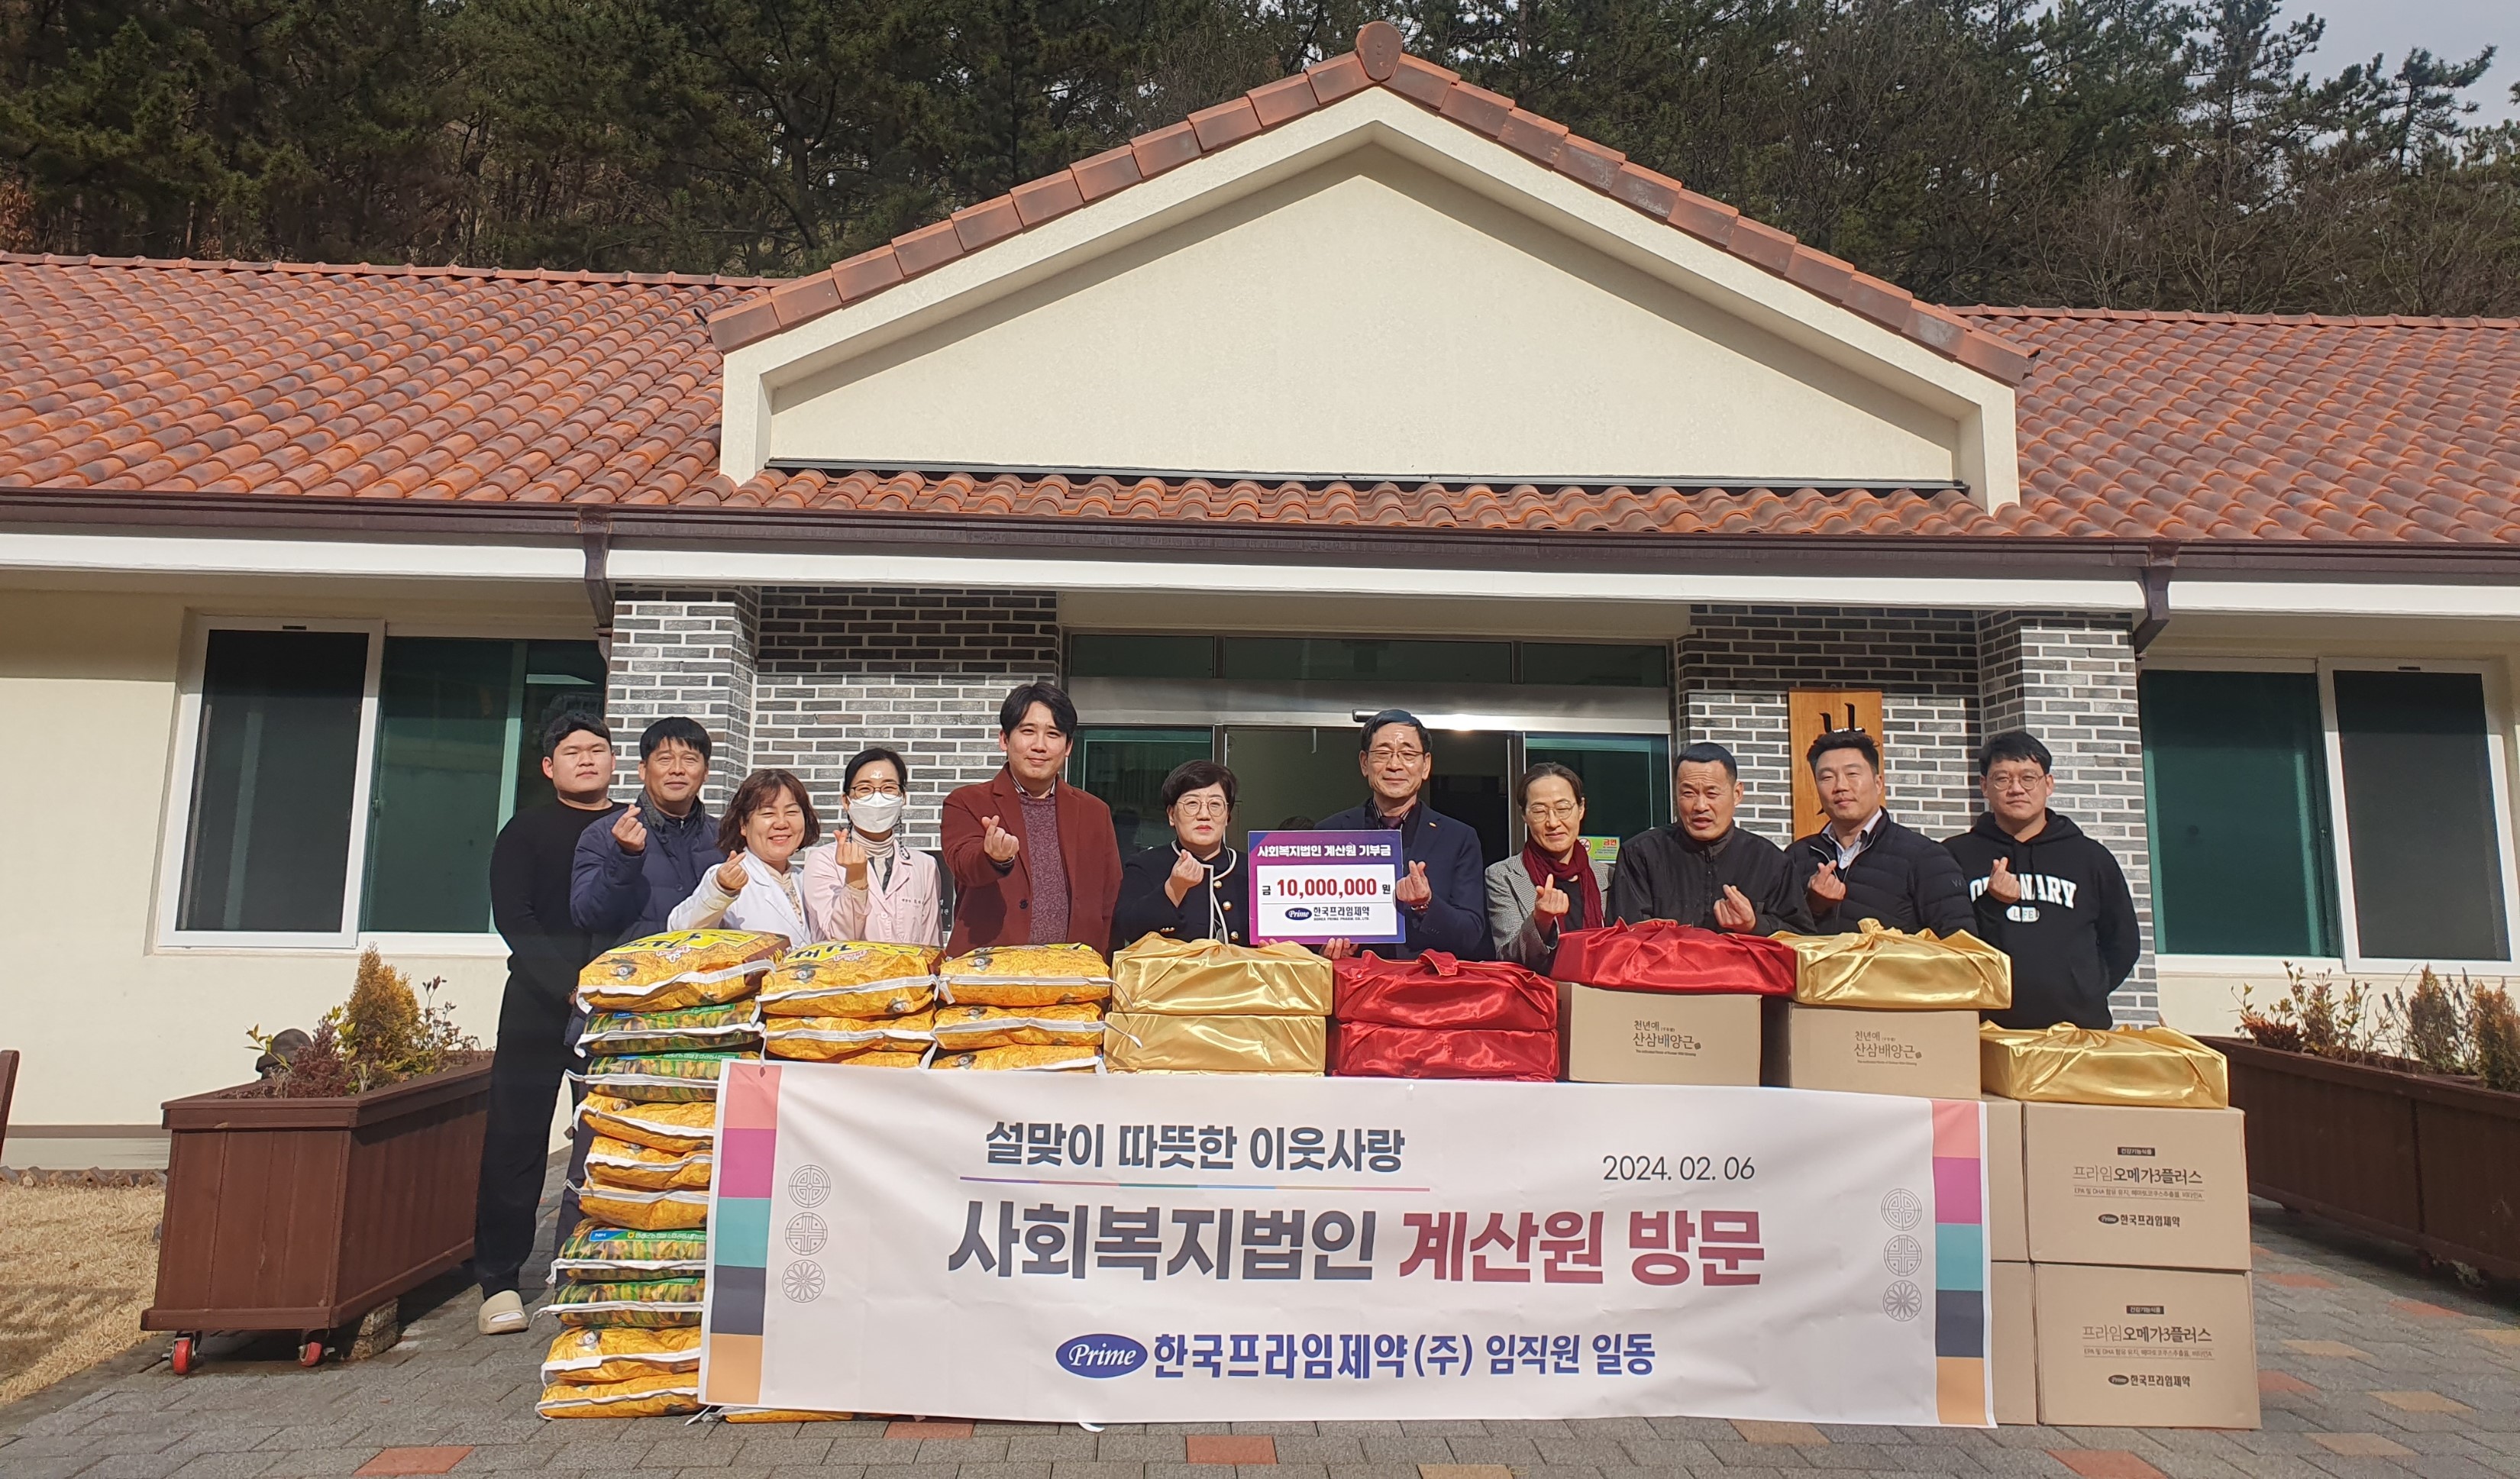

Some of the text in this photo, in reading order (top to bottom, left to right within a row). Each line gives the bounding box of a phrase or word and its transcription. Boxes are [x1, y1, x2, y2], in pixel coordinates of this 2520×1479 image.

[1258, 844, 1391, 857] 사회복지법인 계산원 기부금
[1262, 878, 1391, 899] 금 10,000,000 원
[1970, 874, 2076, 909] ONARY
[1313, 906, 1369, 917] 한국프라임제약
[1633, 1032, 1695, 1049] 산삼배양근
[1854, 1043, 1915, 1059] 산삼배양근
[987, 1122, 1405, 1173] 설맞이 따뜻한 이웃사랑
[1604, 1156, 1756, 1181] 2024. 02. 06
[2073, 1165, 2203, 1185] 프라임오메가3플러스
[2121, 1214, 2180, 1228] 한국프라임제약
[948, 1201, 1766, 1287] 사회복지법인 계산원 방문
[2082, 1325, 2212, 1343] 프라임오메가3플러스
[1068, 1334, 1656, 1380] Prime 한국프라임제약(주) 임직원 일동
[2131, 1375, 2190, 1387] 한국프라임제약
